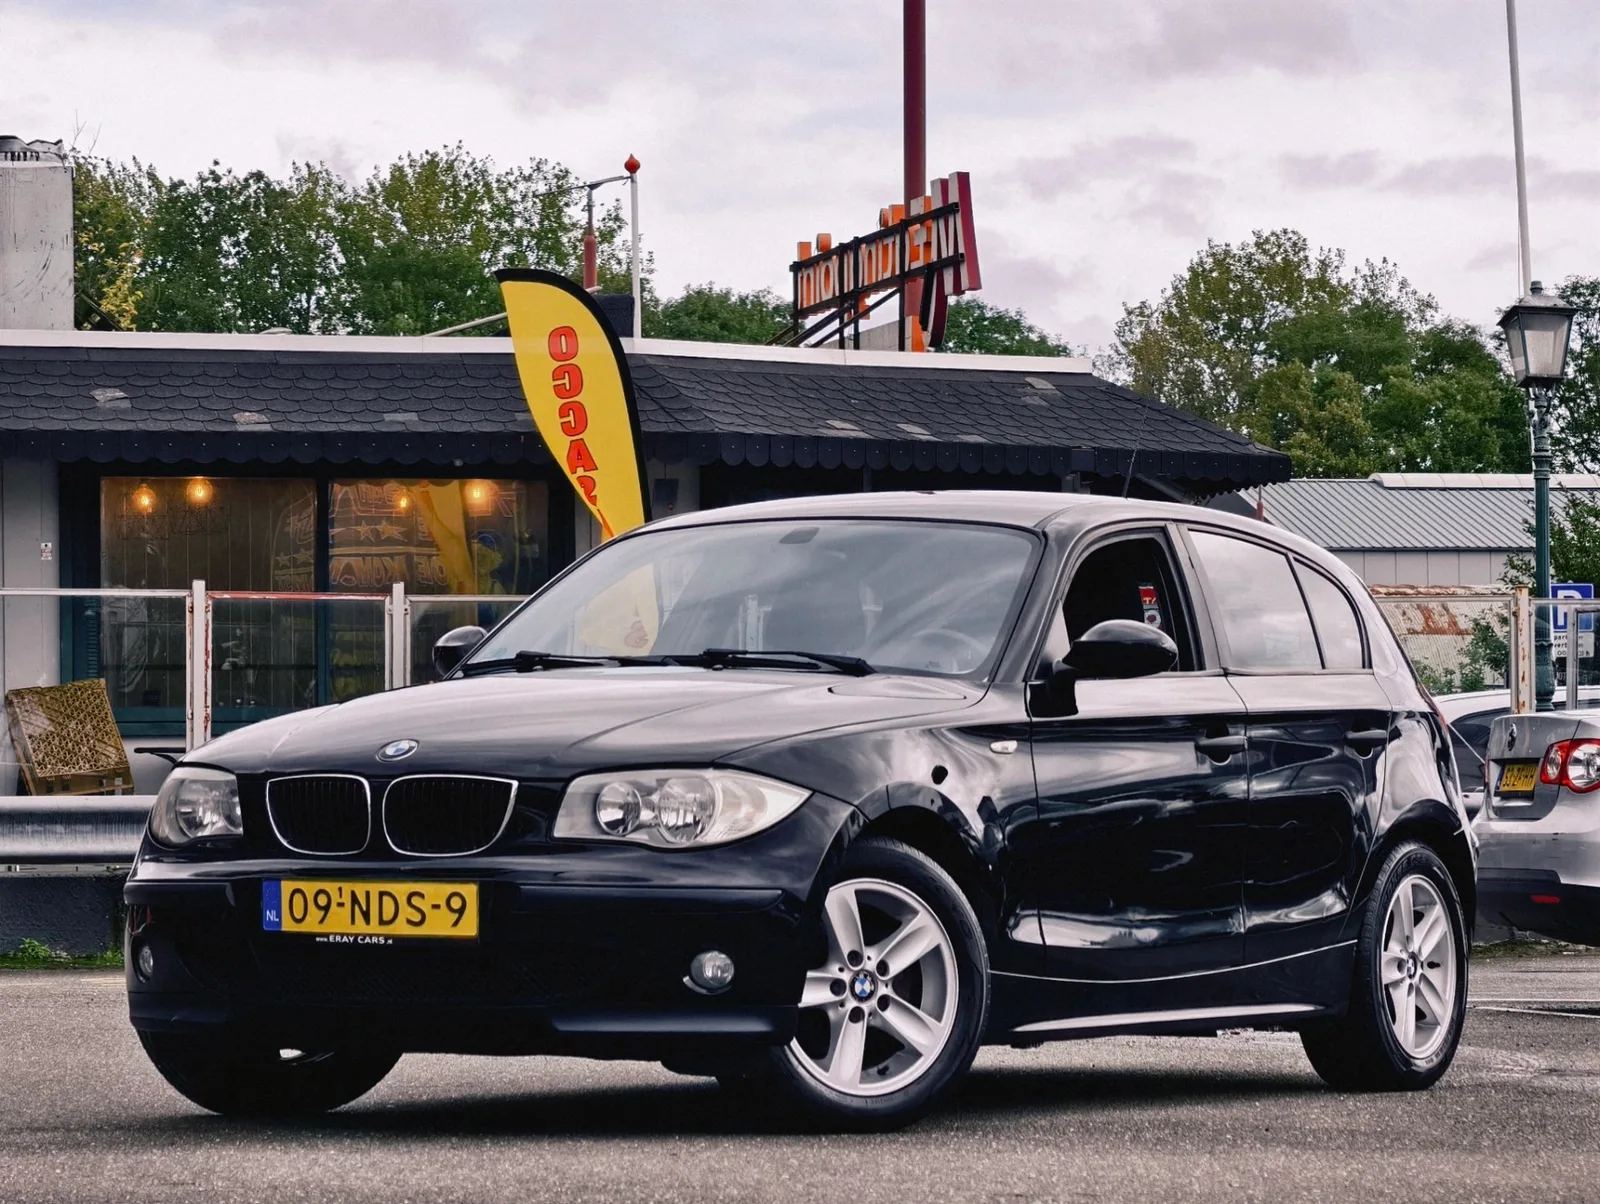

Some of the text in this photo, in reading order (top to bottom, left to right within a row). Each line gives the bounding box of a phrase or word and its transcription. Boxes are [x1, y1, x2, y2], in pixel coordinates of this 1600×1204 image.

[266, 909, 279, 922] NL
[329, 934, 355, 943] ERAY
[357, 936, 385, 945] CARS
